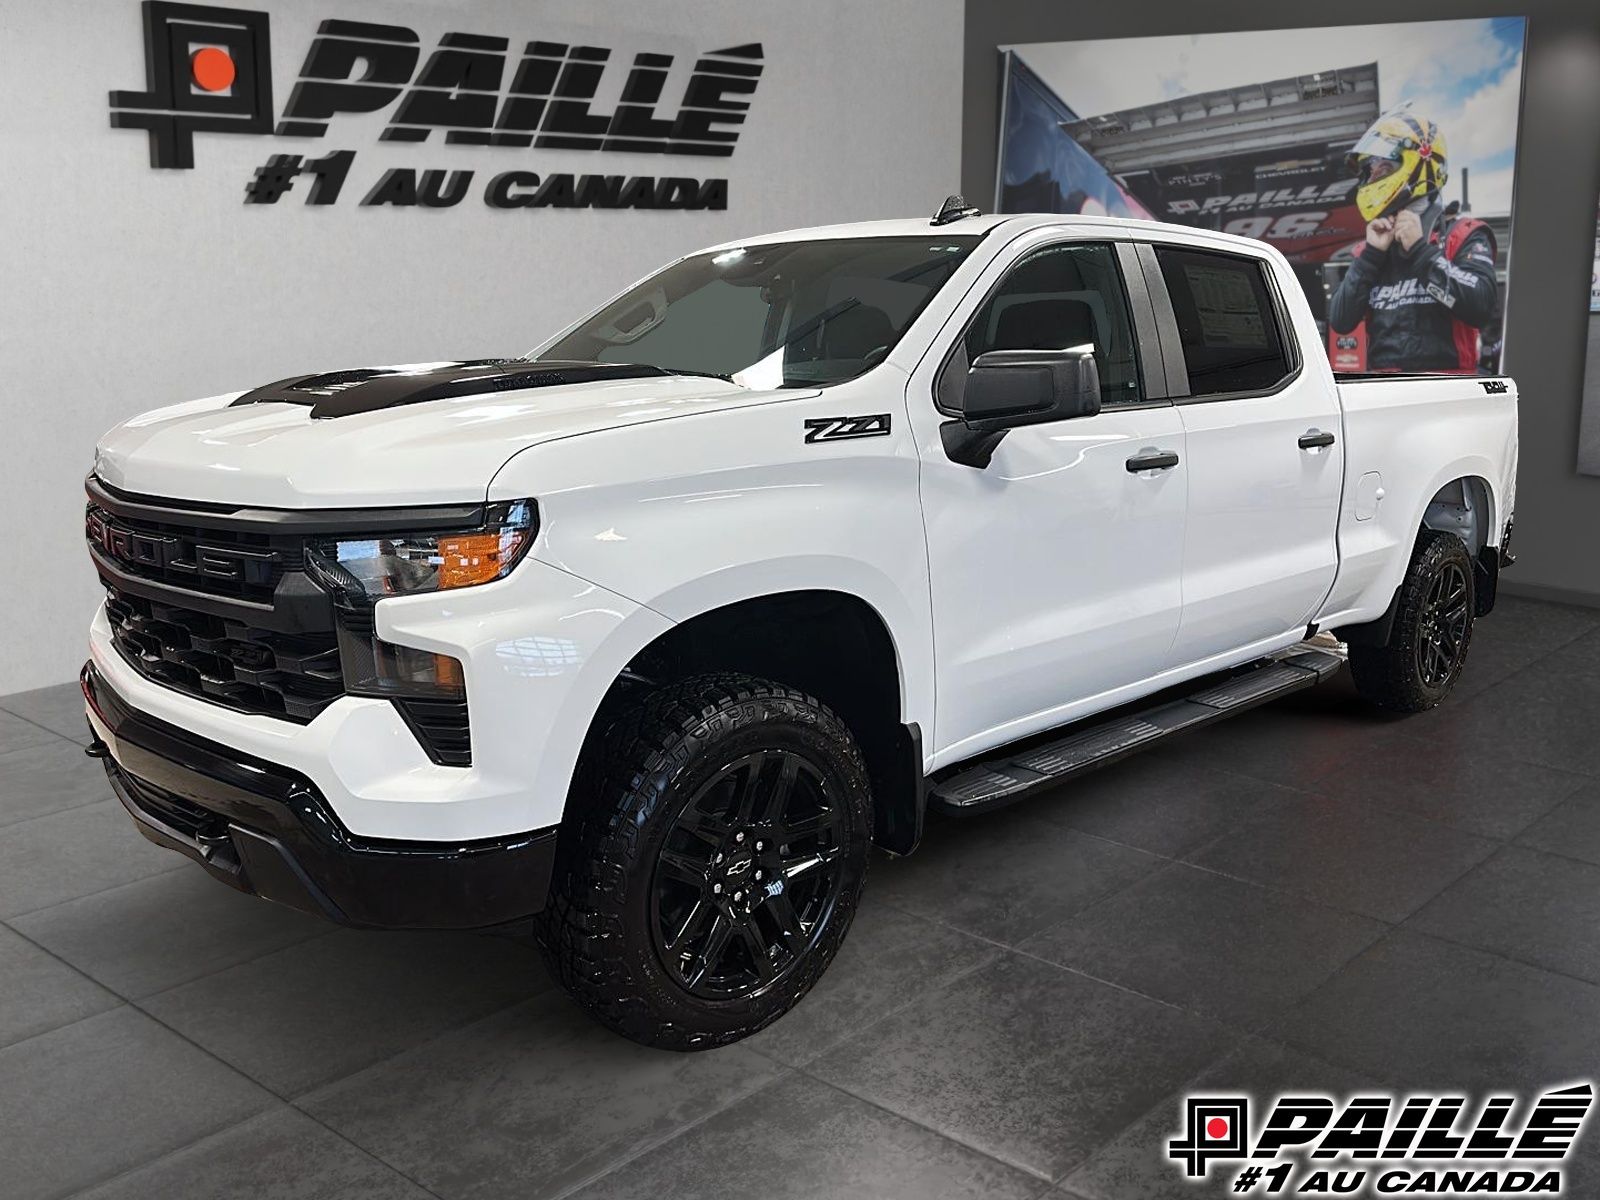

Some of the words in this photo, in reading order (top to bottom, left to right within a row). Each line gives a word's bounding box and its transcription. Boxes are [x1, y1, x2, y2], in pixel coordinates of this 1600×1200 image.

[275, 19, 764, 156] PAILLÉ
[244, 150, 357, 205] #1
[359, 168, 475, 207] AU
[483, 171, 728, 210] CANADA
[1225, 205, 1253, 213] AU
[1258, 196, 1346, 209] CANADA
[1225, 212, 1329, 239] 96
[804, 413, 892, 444] Z71
